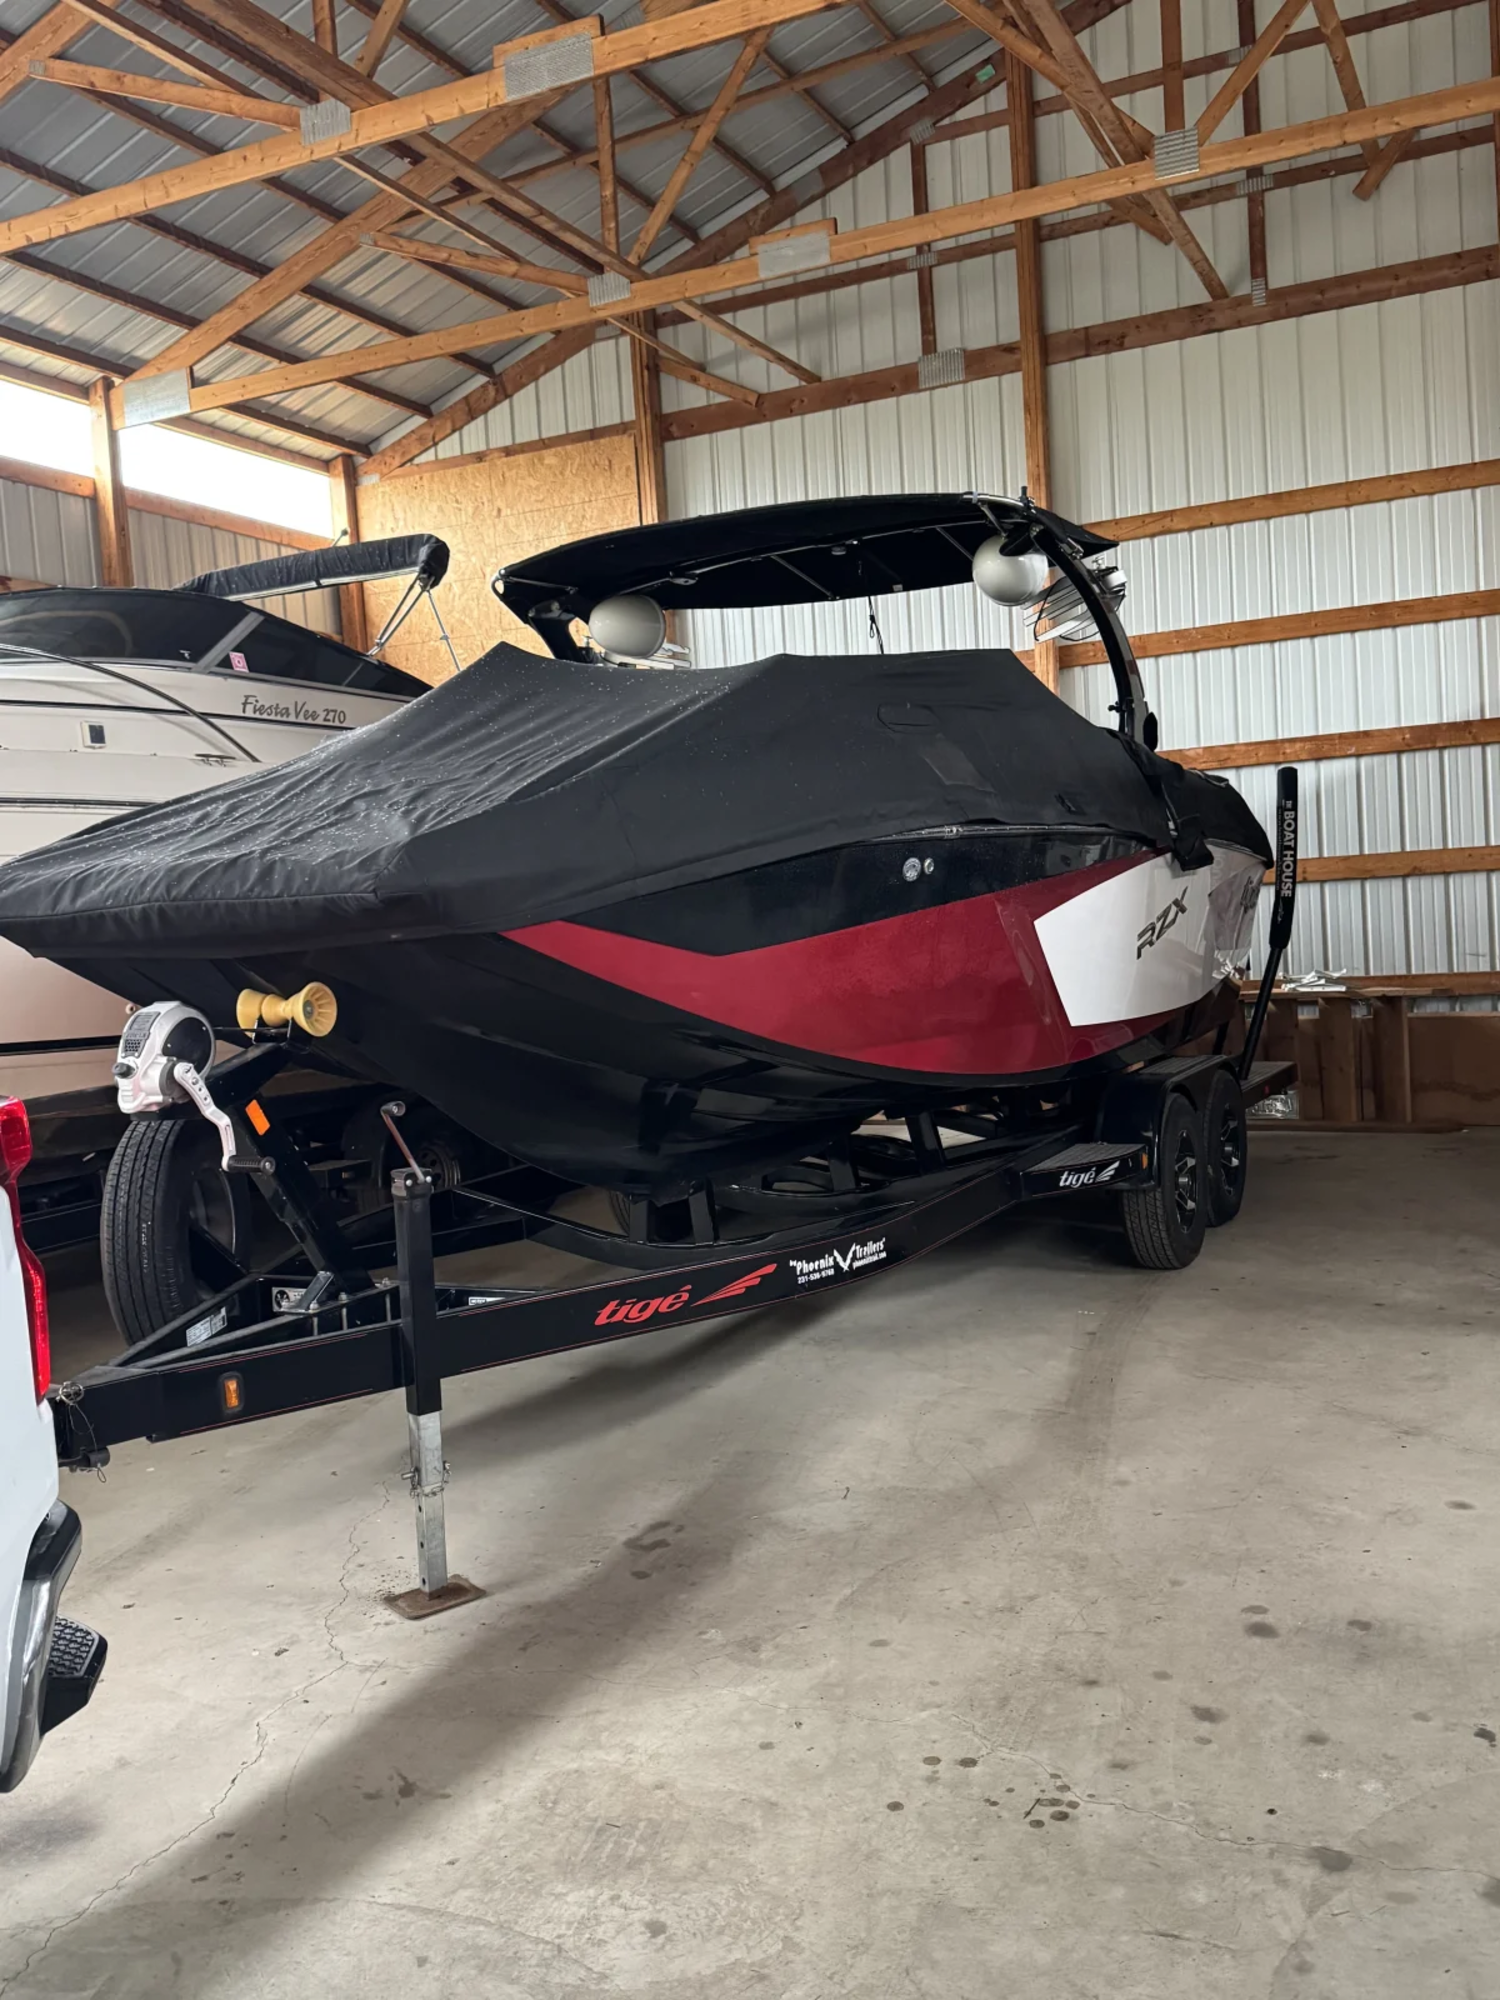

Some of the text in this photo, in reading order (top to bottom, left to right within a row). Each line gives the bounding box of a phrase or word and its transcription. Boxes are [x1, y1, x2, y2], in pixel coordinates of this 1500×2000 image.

[241, 695, 347, 724] Fiesta Vee 270
[1283, 811, 1295, 848] BOAT
[1281, 850, 1294, 898] HOUSE
[1137, 885, 1188, 960] RZX
[796, 1253, 835, 1276] Phoenix
[594, 1284, 692, 1326] tigé
